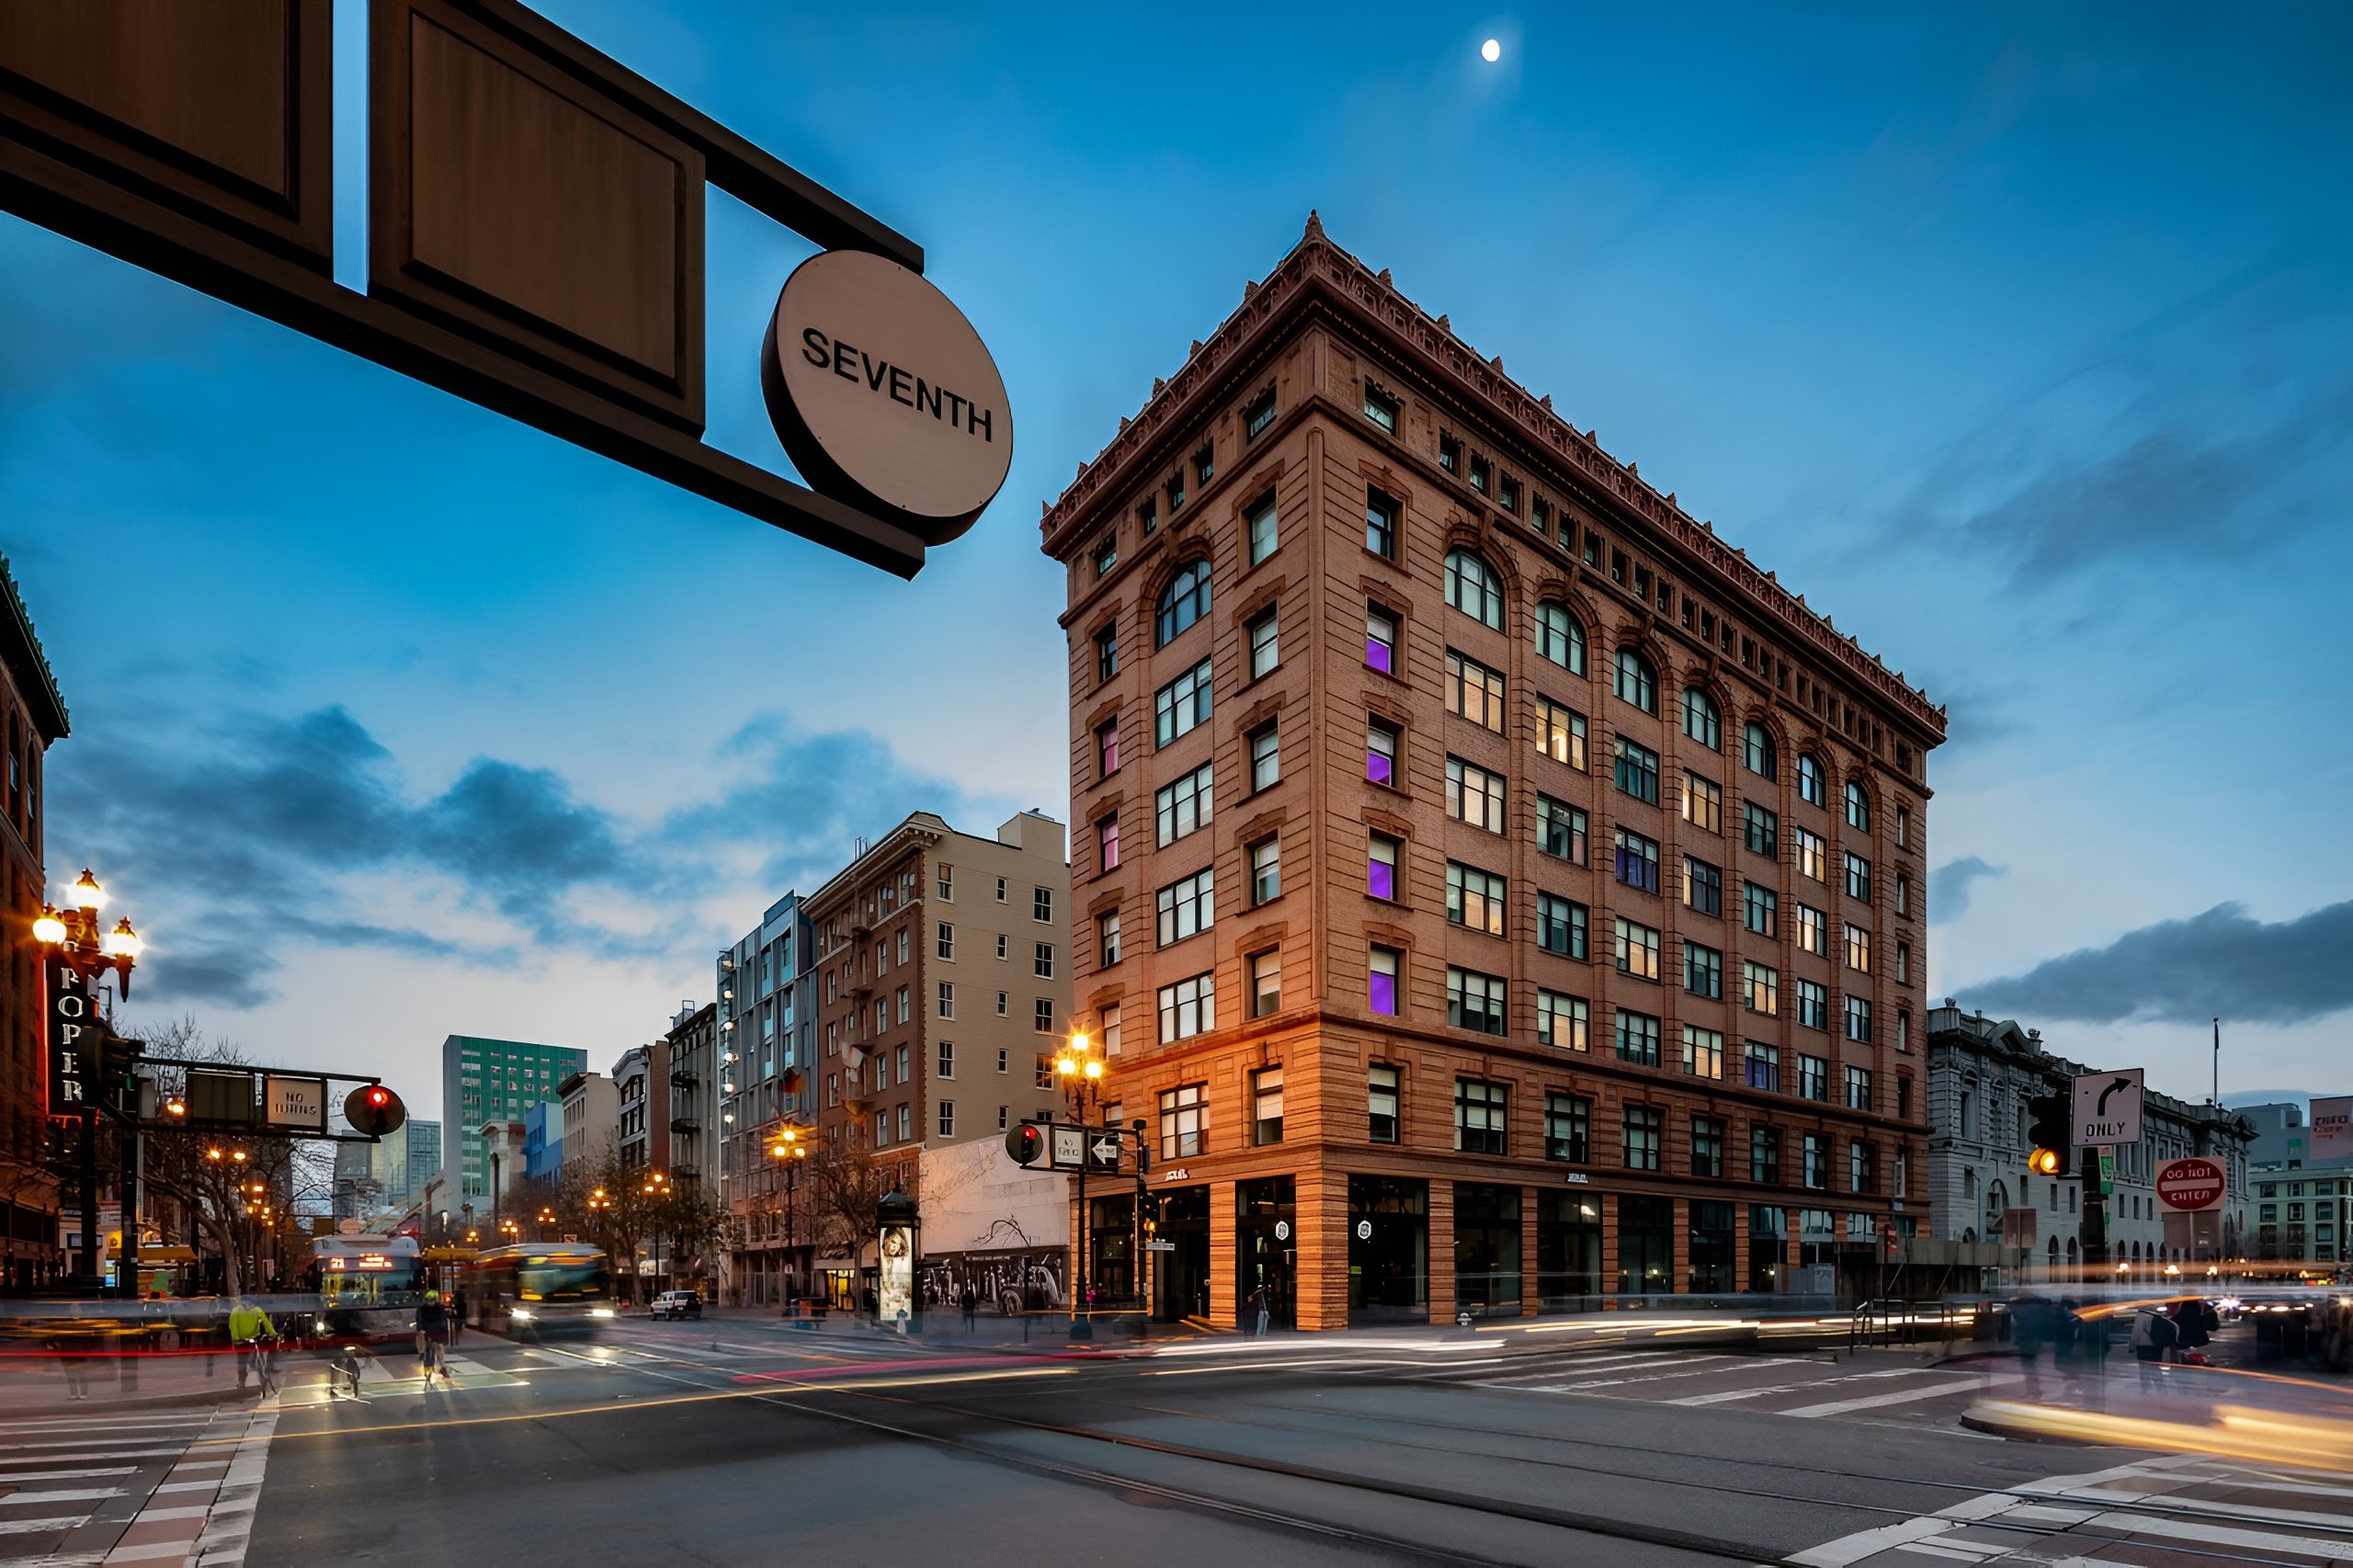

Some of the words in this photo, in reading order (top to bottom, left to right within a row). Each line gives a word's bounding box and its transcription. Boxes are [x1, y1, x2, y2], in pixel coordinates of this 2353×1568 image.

[801, 327, 992, 443] SEVENTH
[286, 1092, 303, 1103] NO
[2086, 1121, 2125, 1137] ONLY
[2166, 1169, 2184, 1179] DO
[2188, 1167, 2211, 1177] NOT
